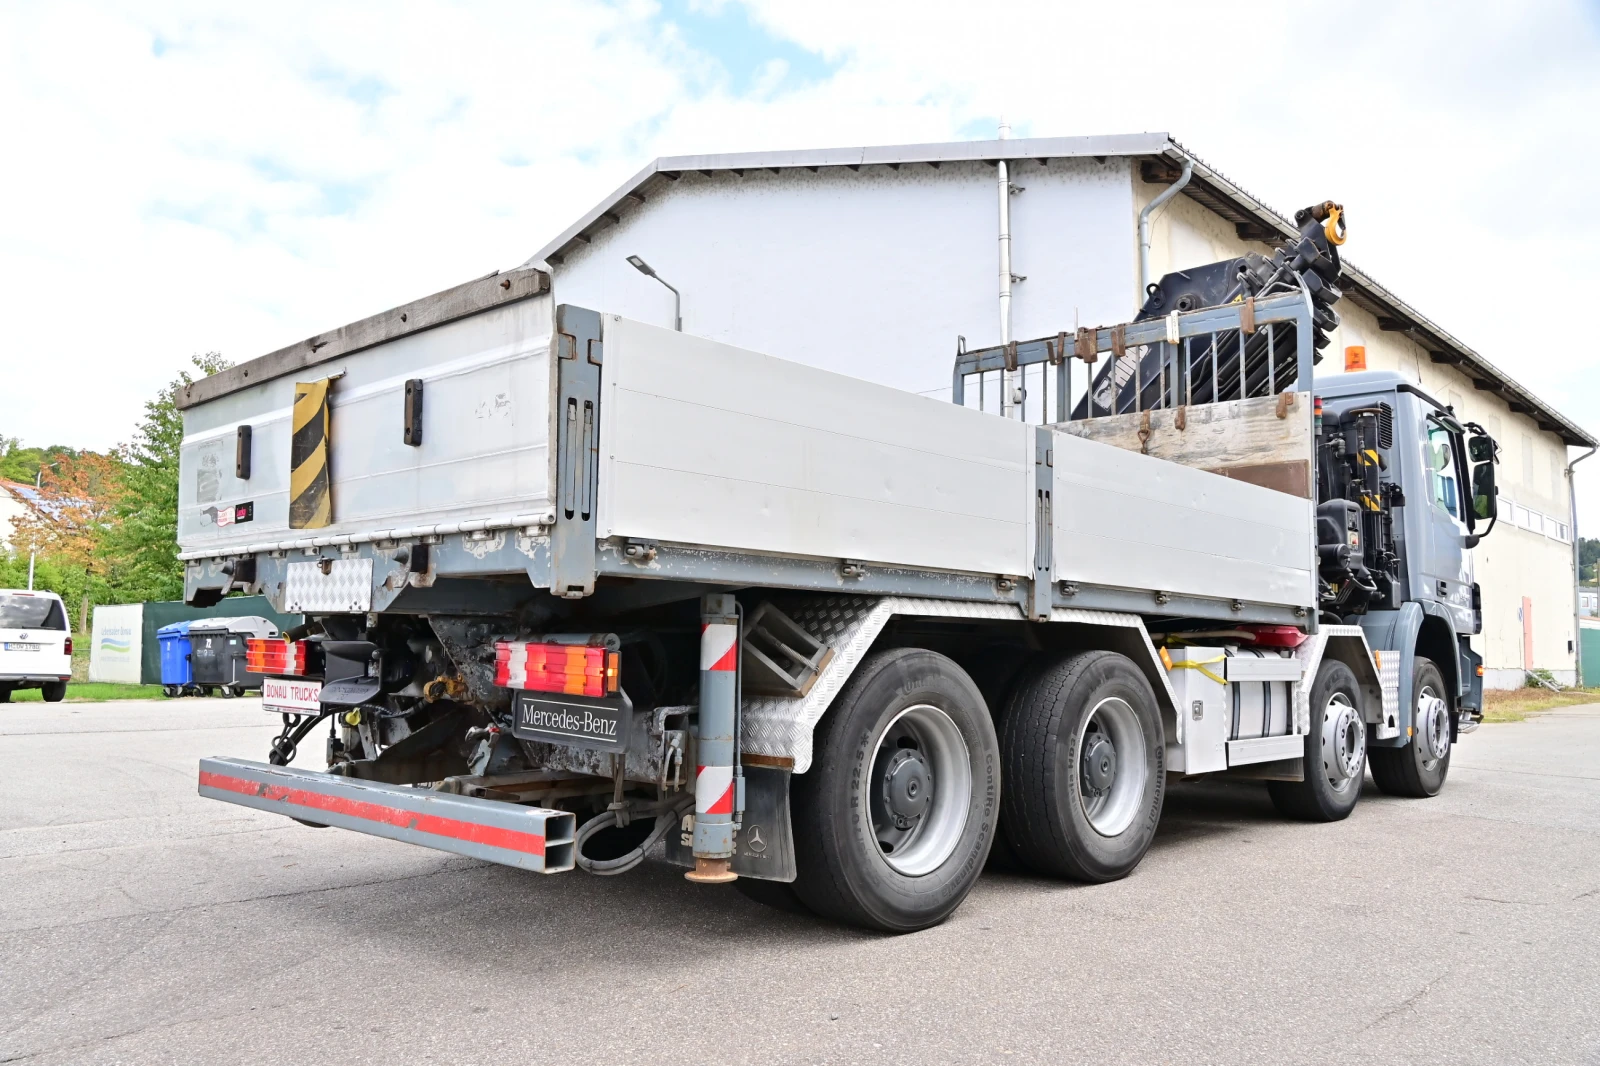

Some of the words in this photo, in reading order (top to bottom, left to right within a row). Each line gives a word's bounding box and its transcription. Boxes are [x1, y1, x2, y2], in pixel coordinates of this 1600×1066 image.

[266, 684, 287, 699] DONAU
[290, 686, 319, 702] TRUCKS
[521, 703, 617, 736] Mercedes-Benz
[984, 753, 994, 817] ContiRe
[1148, 745, 1164, 823] Continental
[941, 821, 989, 898] Scandinavia
